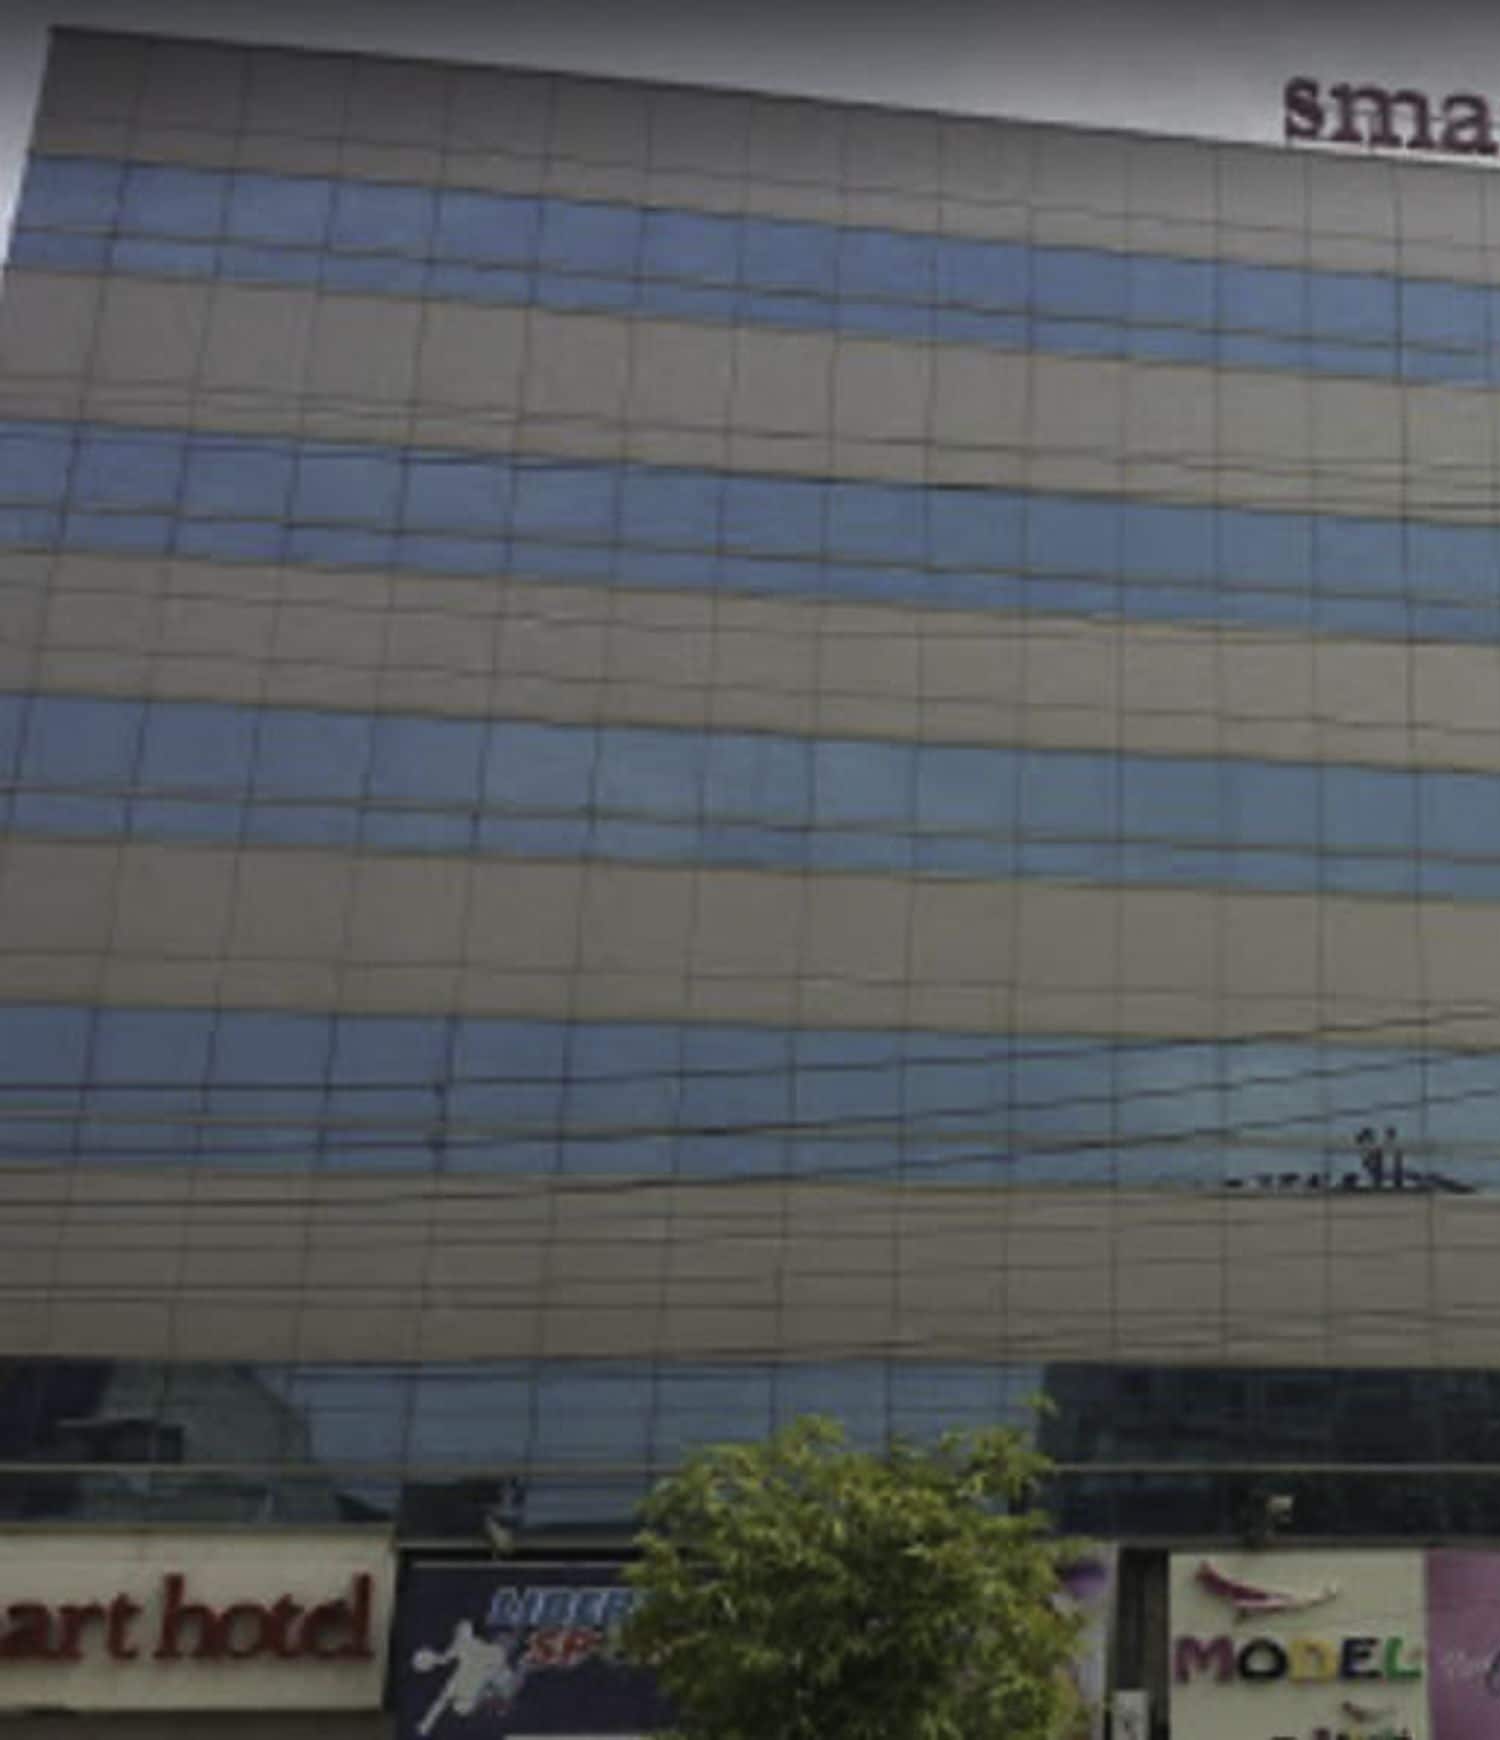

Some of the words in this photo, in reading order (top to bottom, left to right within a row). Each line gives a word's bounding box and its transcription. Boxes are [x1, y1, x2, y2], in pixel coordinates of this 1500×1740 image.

[0, 1590, 142, 1662] art
[153, 1572, 376, 1662] hotel
[486, 1585, 644, 1627] LIBER
[1174, 1636, 1423, 1684] MODEL
